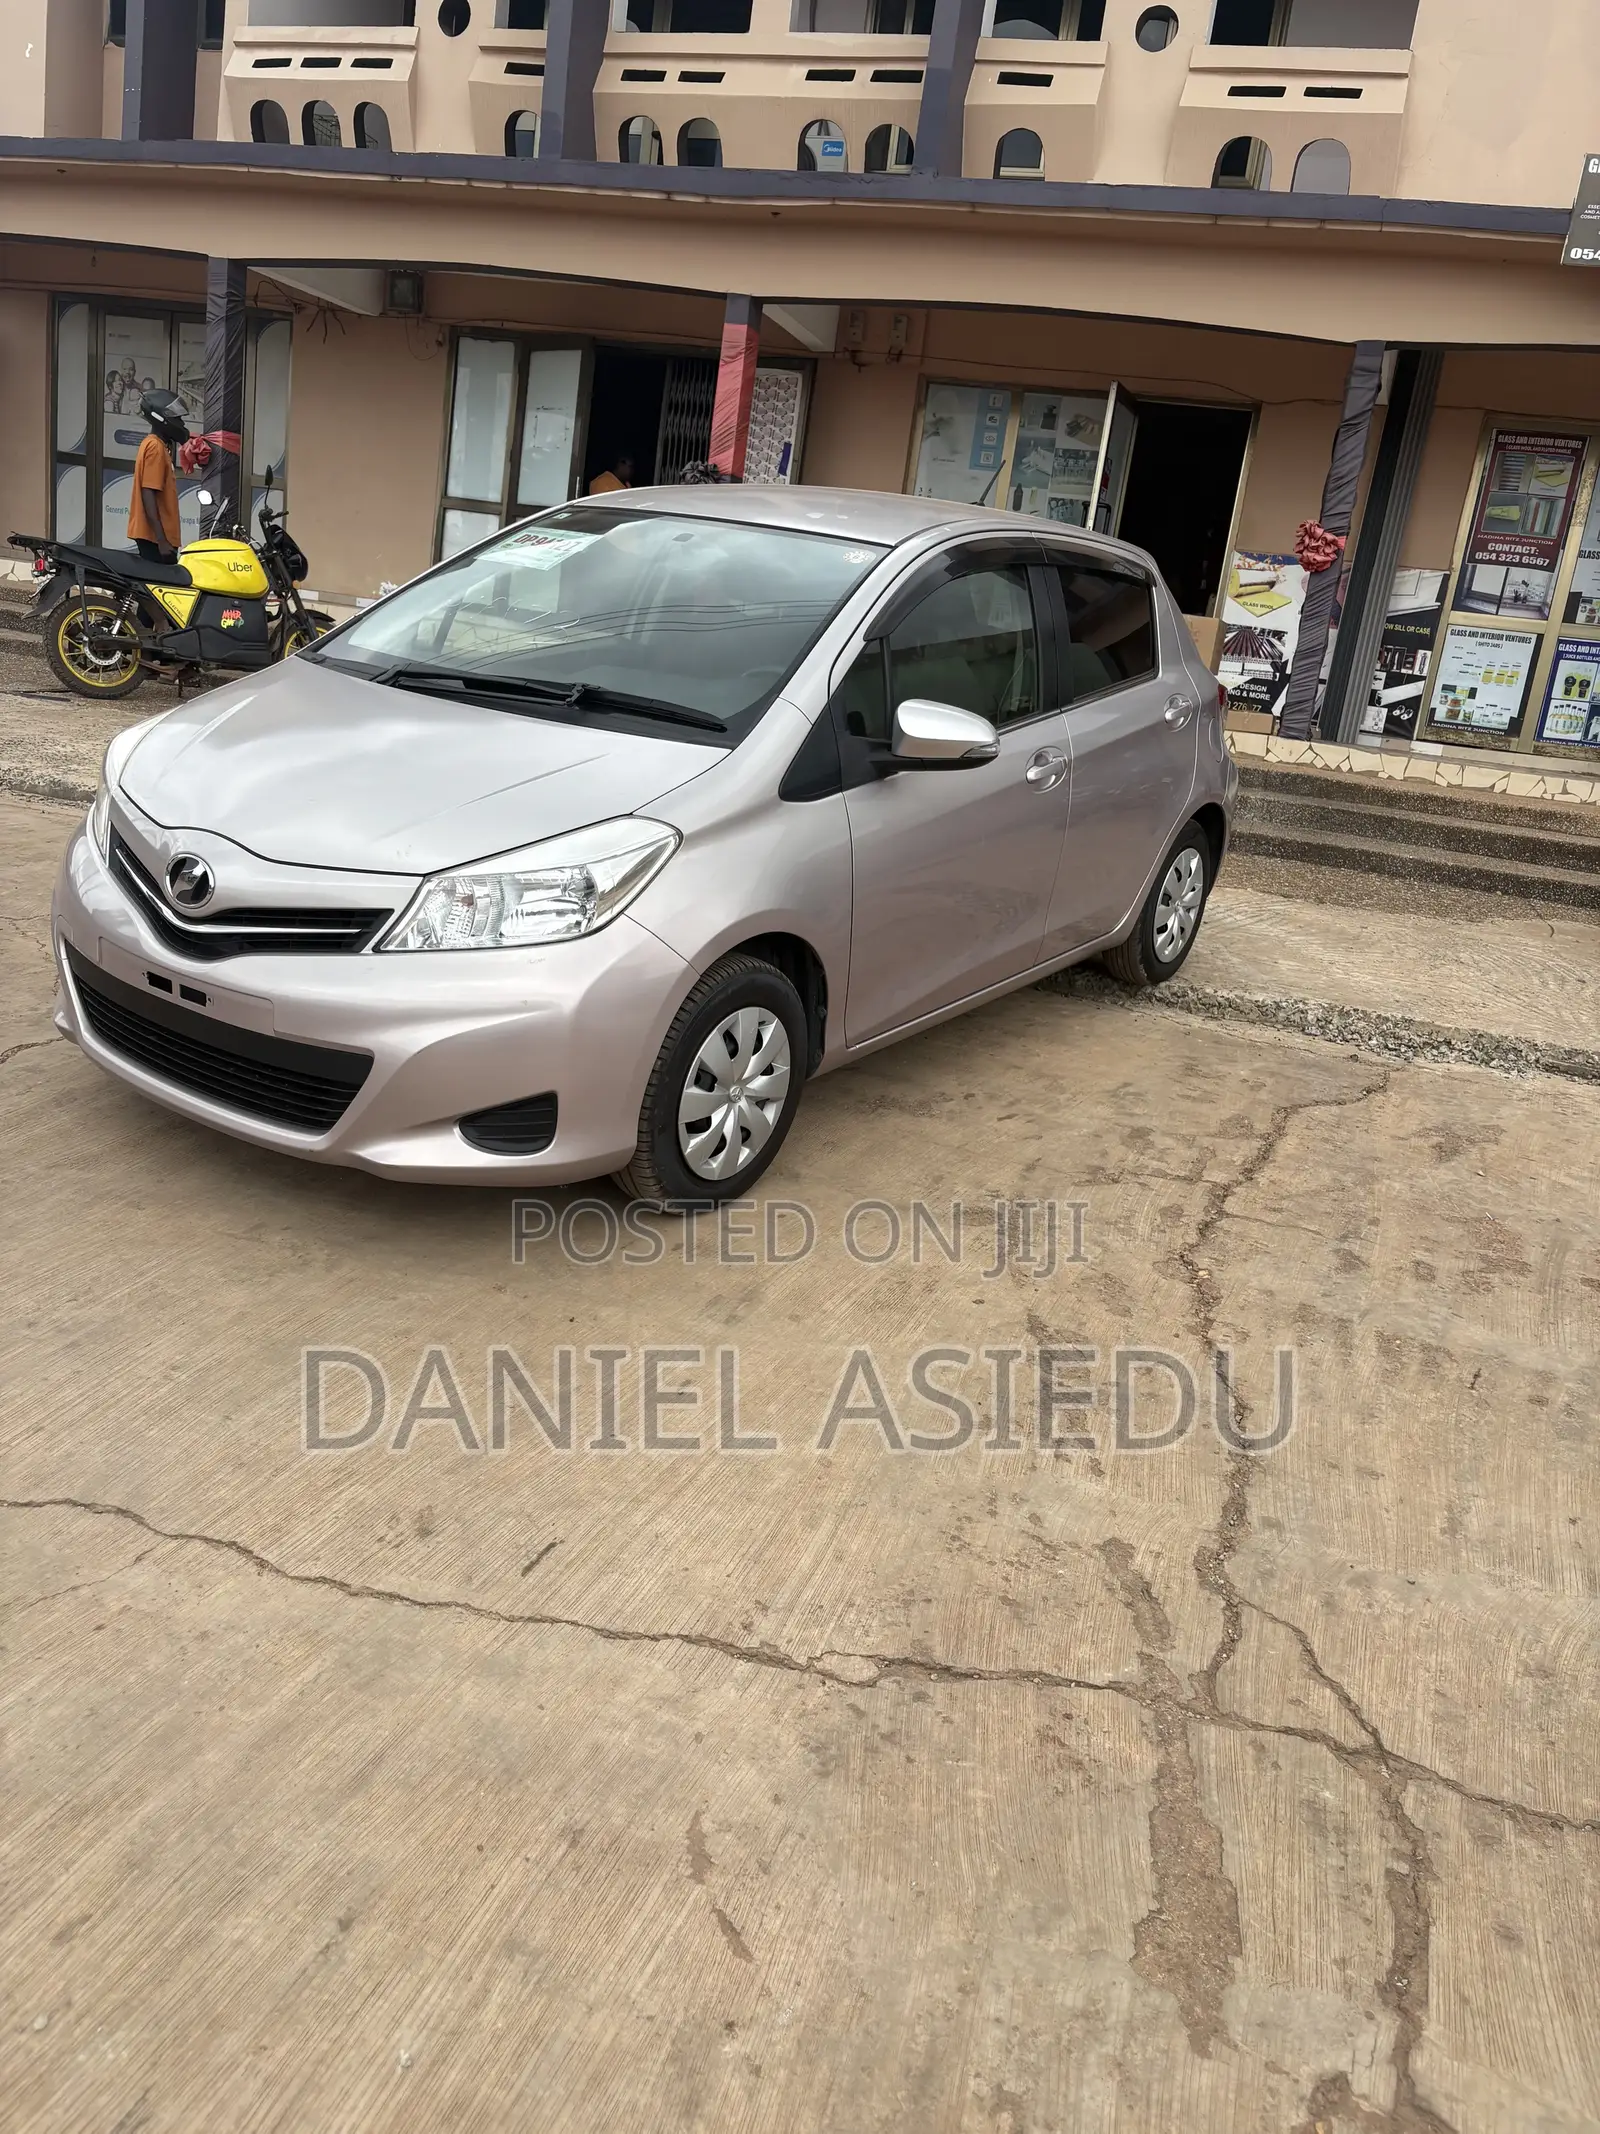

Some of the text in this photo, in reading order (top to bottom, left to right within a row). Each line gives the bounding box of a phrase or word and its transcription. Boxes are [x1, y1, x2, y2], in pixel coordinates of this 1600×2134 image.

[1497, 435, 1583, 449] GLASS AND INTERIOR VENTURES
[1487, 543, 1540, 555] CONTACT:
[1475, 552, 1550, 567] 054 323 6567
[227, 562, 253, 572] Uber
[1394, 624, 1406, 632] SILL
[1406, 625, 1415, 633] OR
[1450, 628, 1533, 645] GLASS AND INTERIOR VENTURES
[1558, 643, 1600, 655] GLASS AND INT
[1240, 683, 1268, 693] DESIGN
[1249, 692, 1271, 701] MORE
[1232, 701, 1248, 711] 276
[1431, 722, 1457, 730] MADINA
[1472, 727, 1505, 736] JUNCTION
